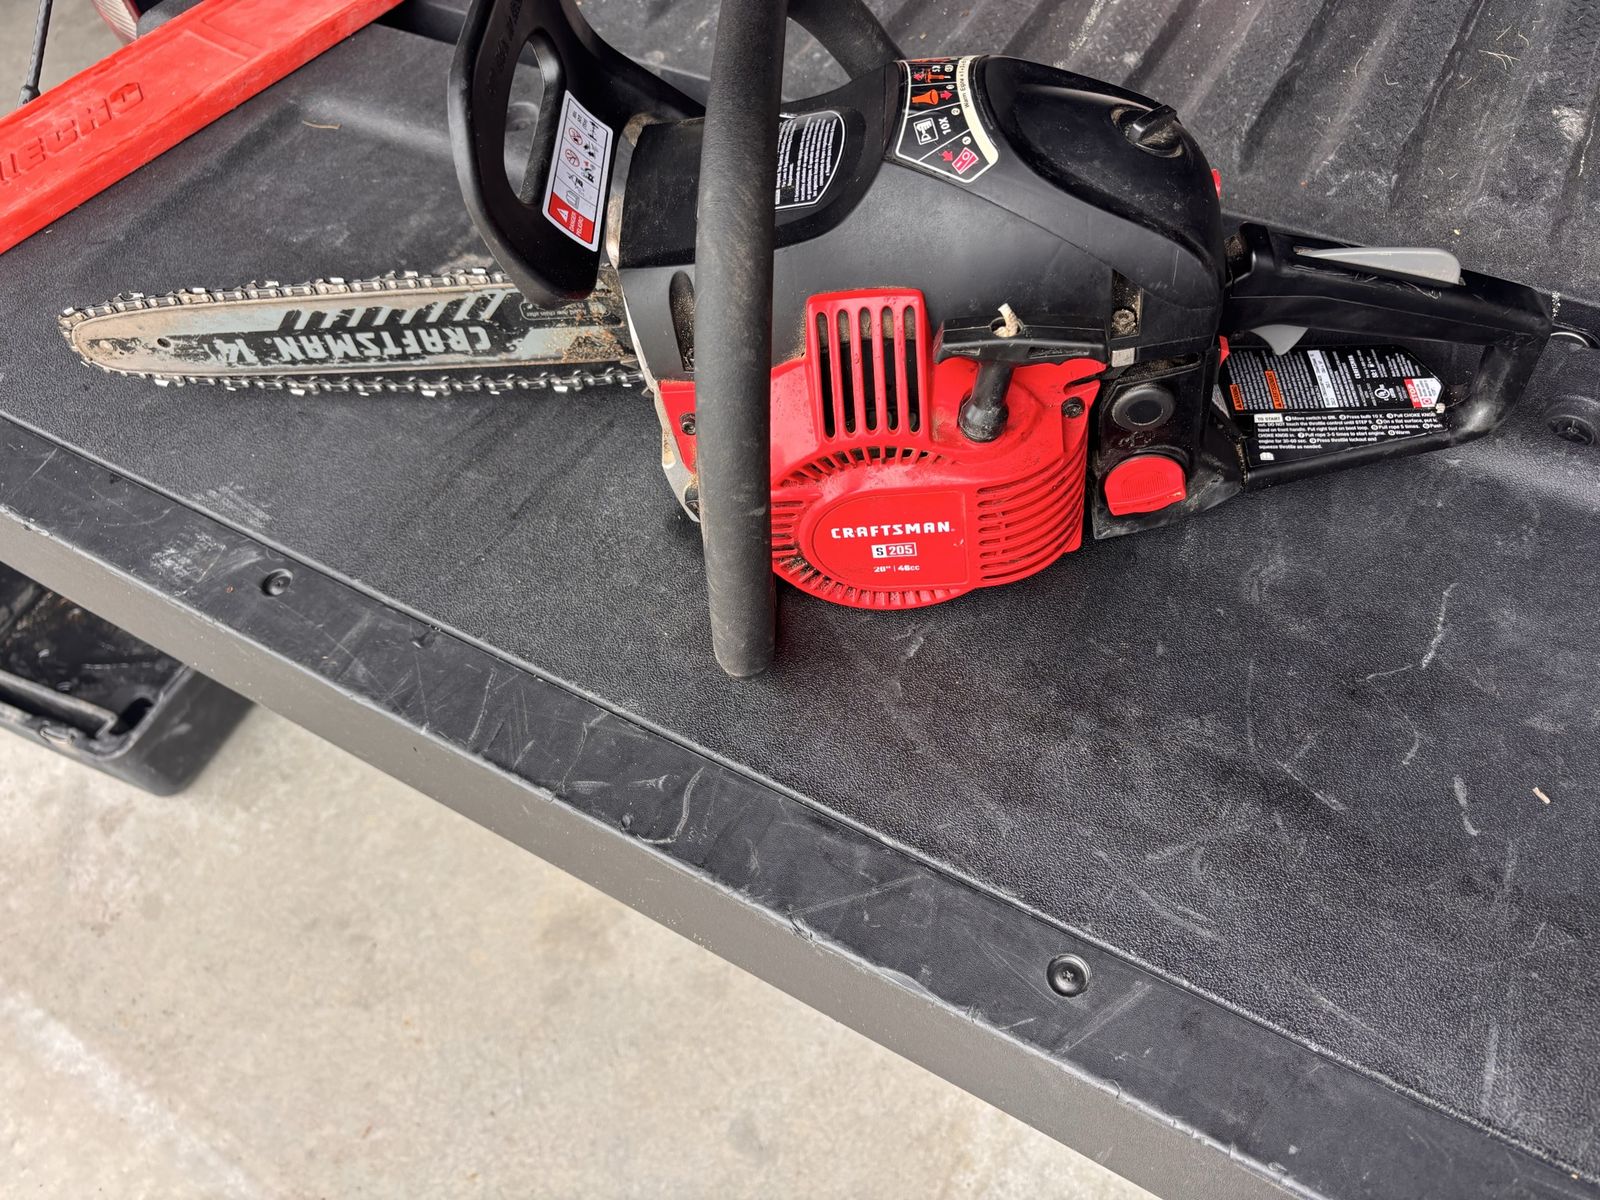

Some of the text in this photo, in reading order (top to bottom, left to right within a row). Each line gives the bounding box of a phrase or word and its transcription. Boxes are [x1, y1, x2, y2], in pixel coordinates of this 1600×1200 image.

[19, 81, 144, 173] ECHO
[938, 117, 952, 135] 10X
[273, 328, 492, 363] CRAFTSMAN
[1348, 355, 1361, 379] CRAFTSMAN
[1408, 384, 1420, 402] STOP
[831, 521, 950, 539] CRAFTSMAN
[888, 545, 913, 556] 205
